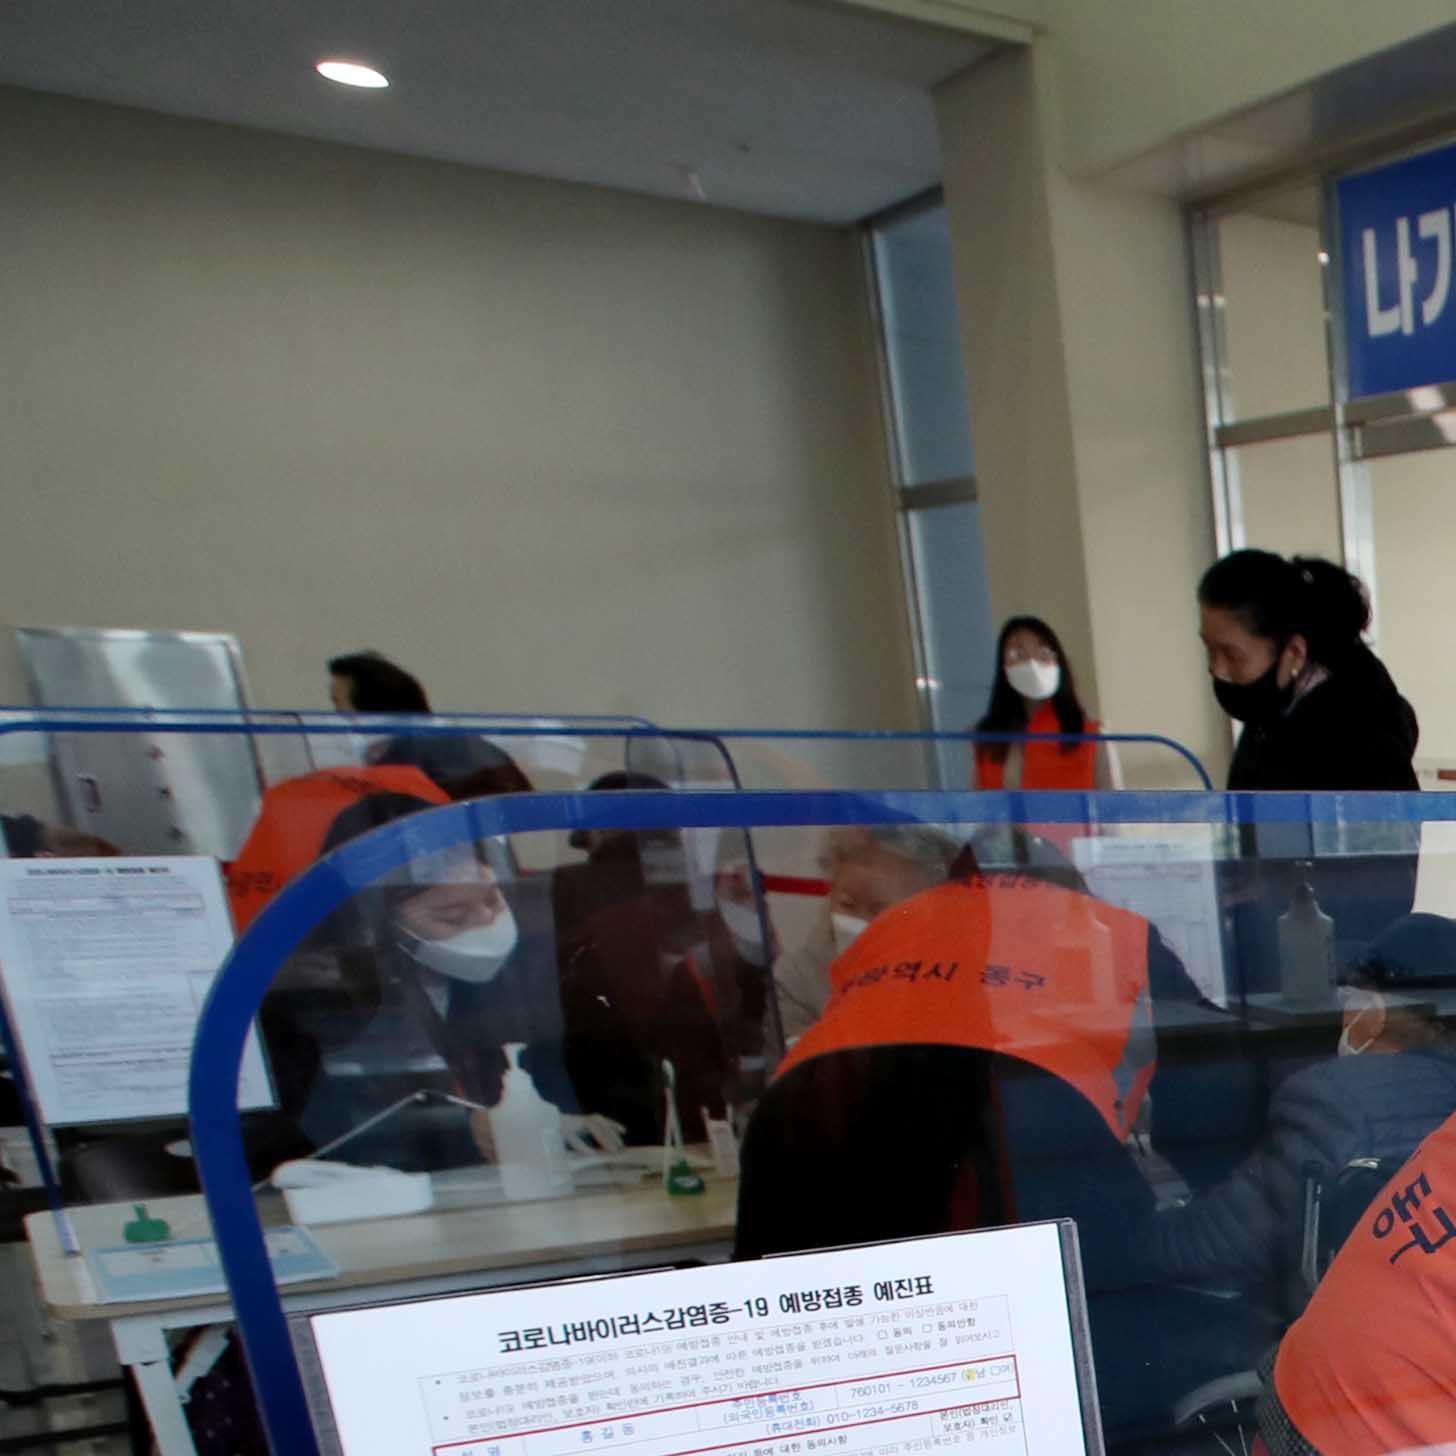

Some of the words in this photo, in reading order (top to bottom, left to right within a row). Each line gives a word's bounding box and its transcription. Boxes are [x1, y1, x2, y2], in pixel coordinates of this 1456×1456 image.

[495, 1295, 770, 1356] 코로나바이러스감염증-19
[778, 1282, 864, 1316] 예방접종
[872, 1272, 935, 1303] 예진표
[849, 1382, 891, 1400] 760101
[909, 1371, 958, 1390] 1234567
[825, 1398, 919, 1424] 010-1234-5678
